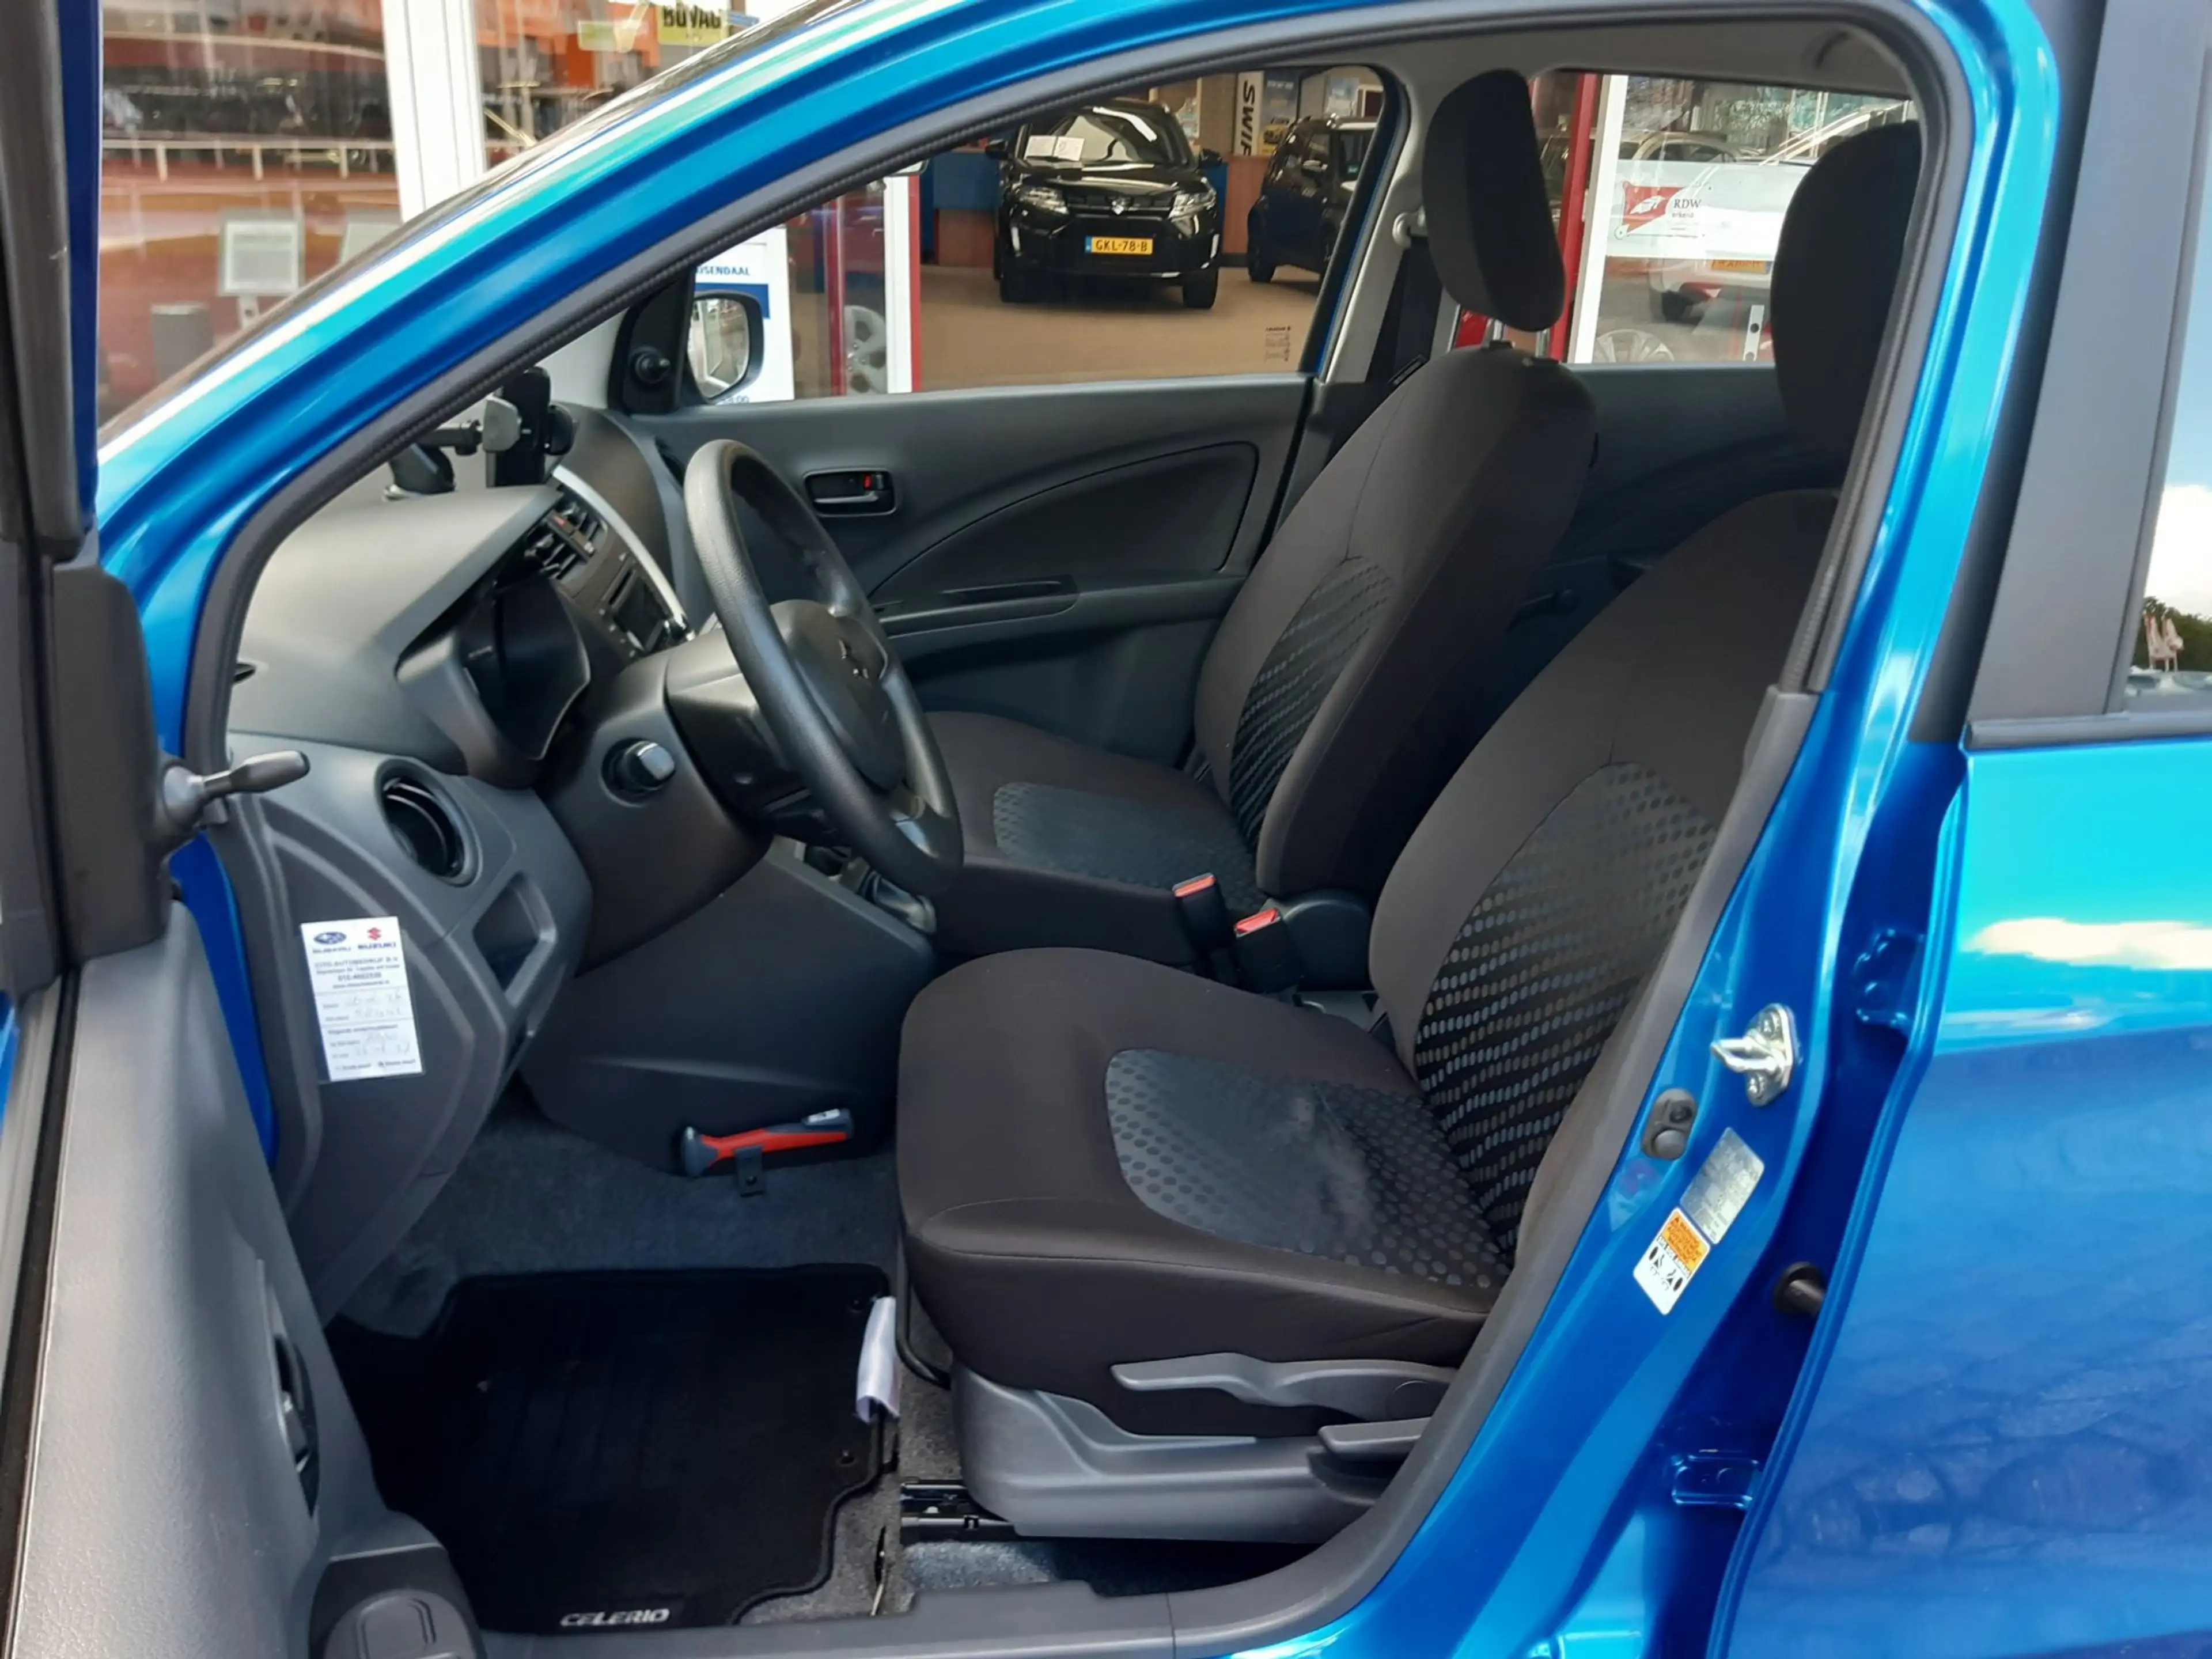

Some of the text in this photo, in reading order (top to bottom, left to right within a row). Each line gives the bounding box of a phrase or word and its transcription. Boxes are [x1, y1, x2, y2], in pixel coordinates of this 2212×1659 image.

[1673, 198, 1702, 209] RDW
[1095, 239, 1148, 252] GKL-78-B
[560, 1608, 669, 1627] CELERIO
